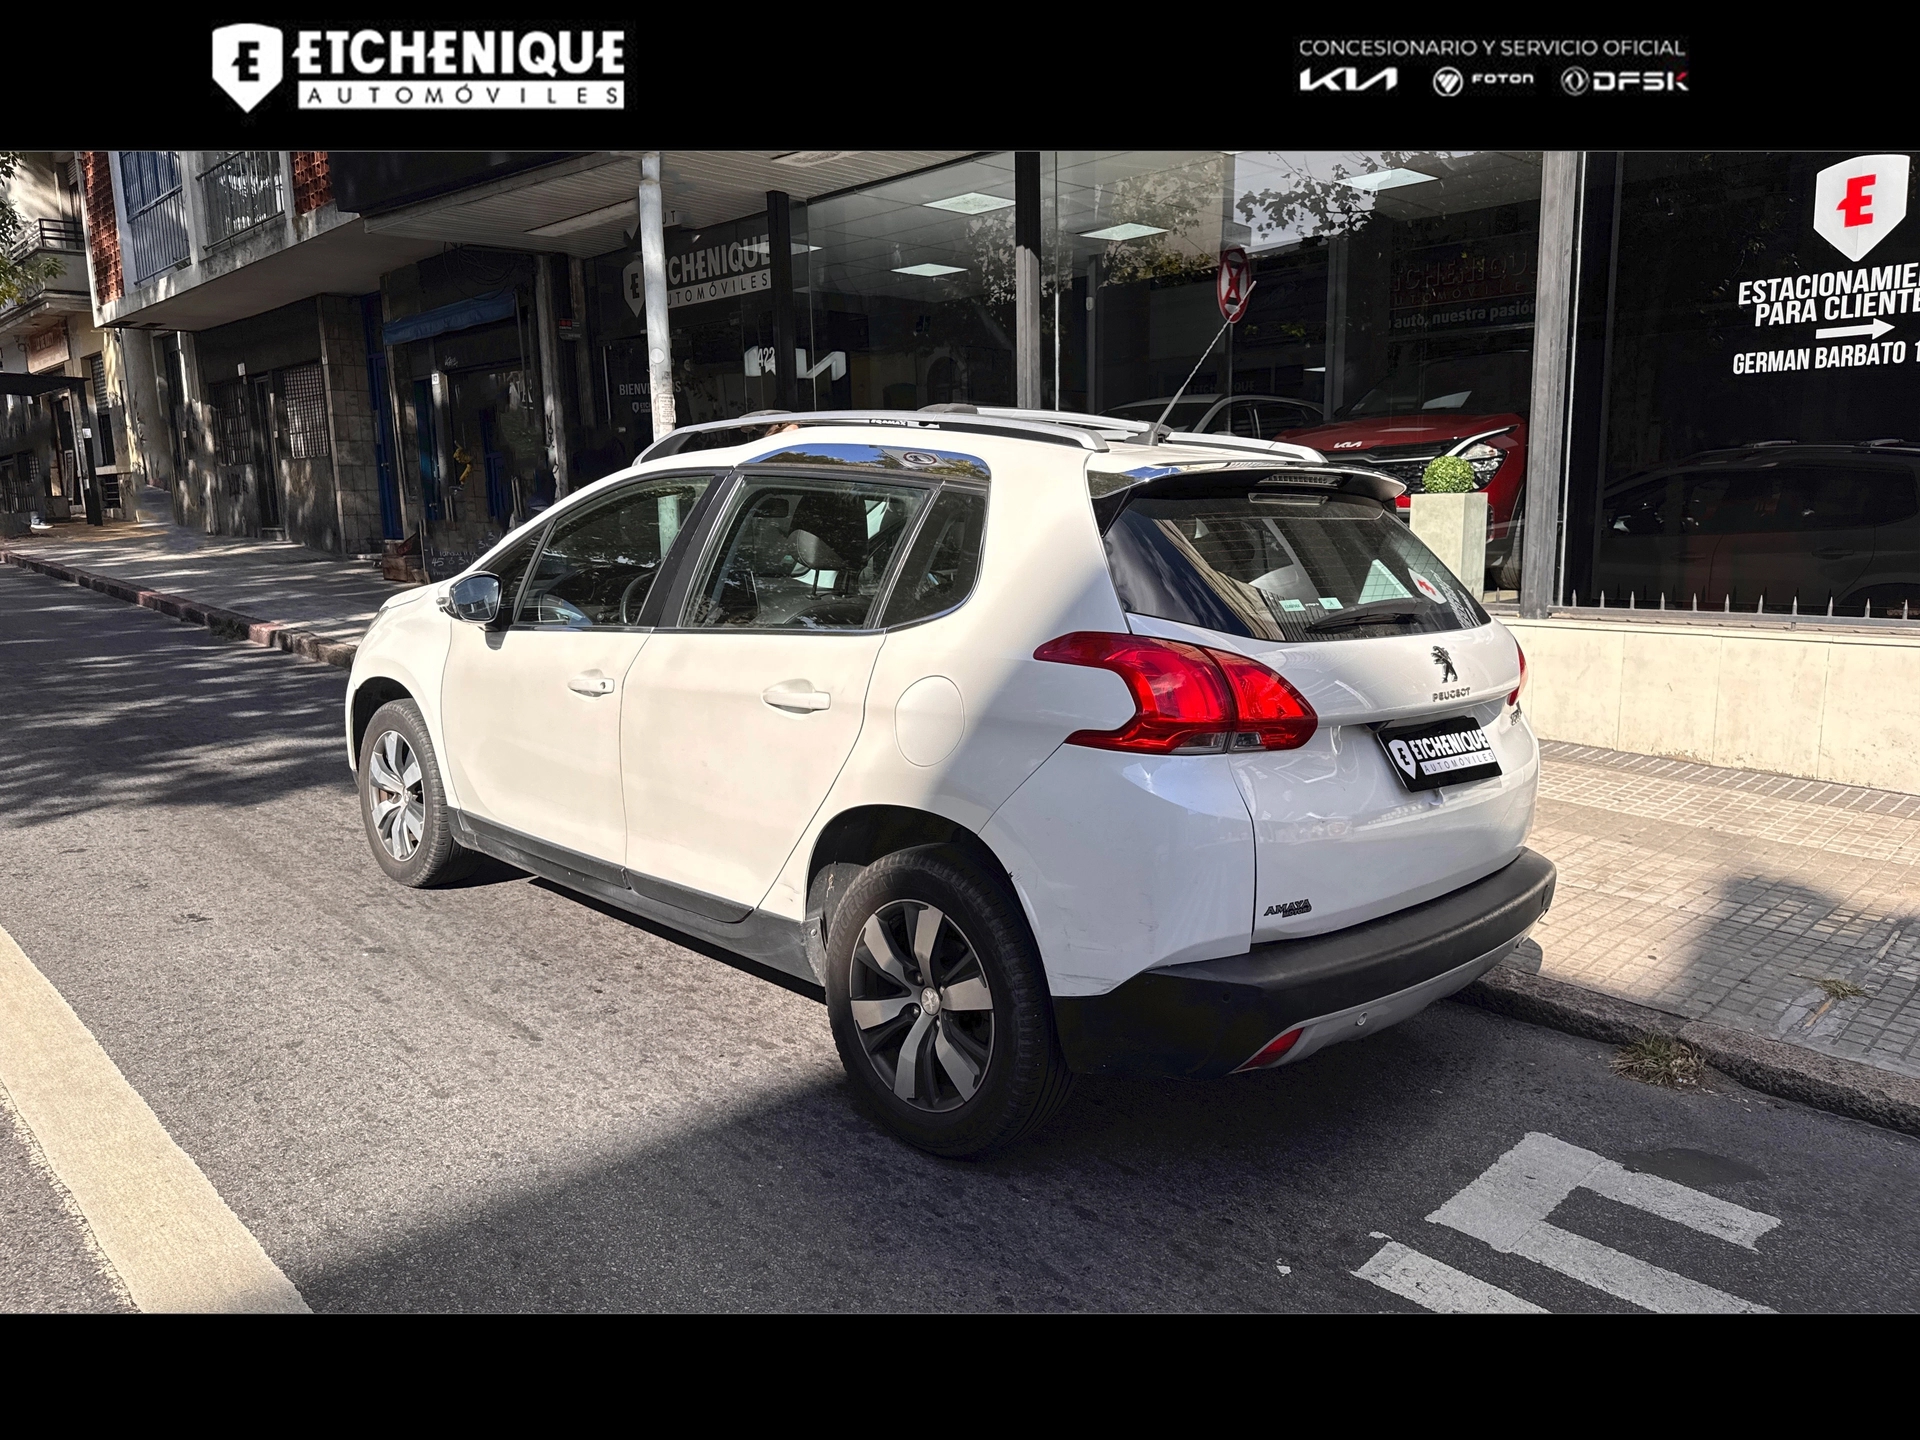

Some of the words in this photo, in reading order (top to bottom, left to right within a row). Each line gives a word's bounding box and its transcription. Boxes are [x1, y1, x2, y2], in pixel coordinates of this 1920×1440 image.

[1738, 262, 1920, 305] ESTACIONAMIE
[1432, 307, 1486, 326] nuestra
[1755, 299, 1817, 327] PARA
[1733, 349, 1810, 374] GERMAN
[1815, 341, 1906, 369] BARBATO
[1433, 687, 1471, 702] PEUGEOT
[1408, 729, 1490, 760] ETCHENIQUE
[1424, 752, 1495, 773] AUTOMÓVILES
[1263, 899, 1311, 916] AMAYA
